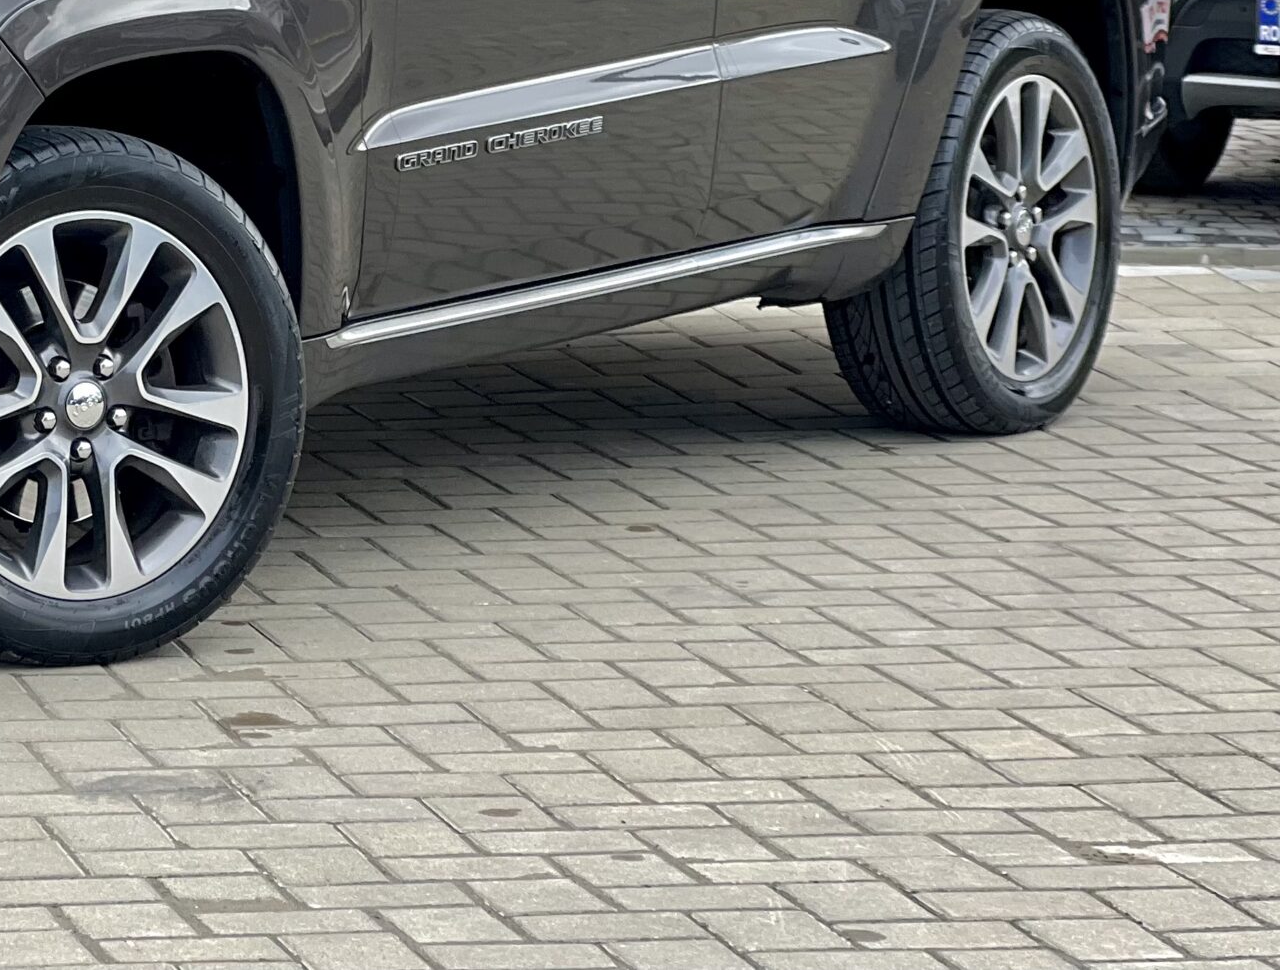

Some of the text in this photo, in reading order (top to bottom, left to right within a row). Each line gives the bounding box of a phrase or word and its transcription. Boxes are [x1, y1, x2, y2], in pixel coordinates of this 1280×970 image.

[1260, 24, 1279, 42] RO
[395, 115, 604, 172] GRAND CHEROKEE
